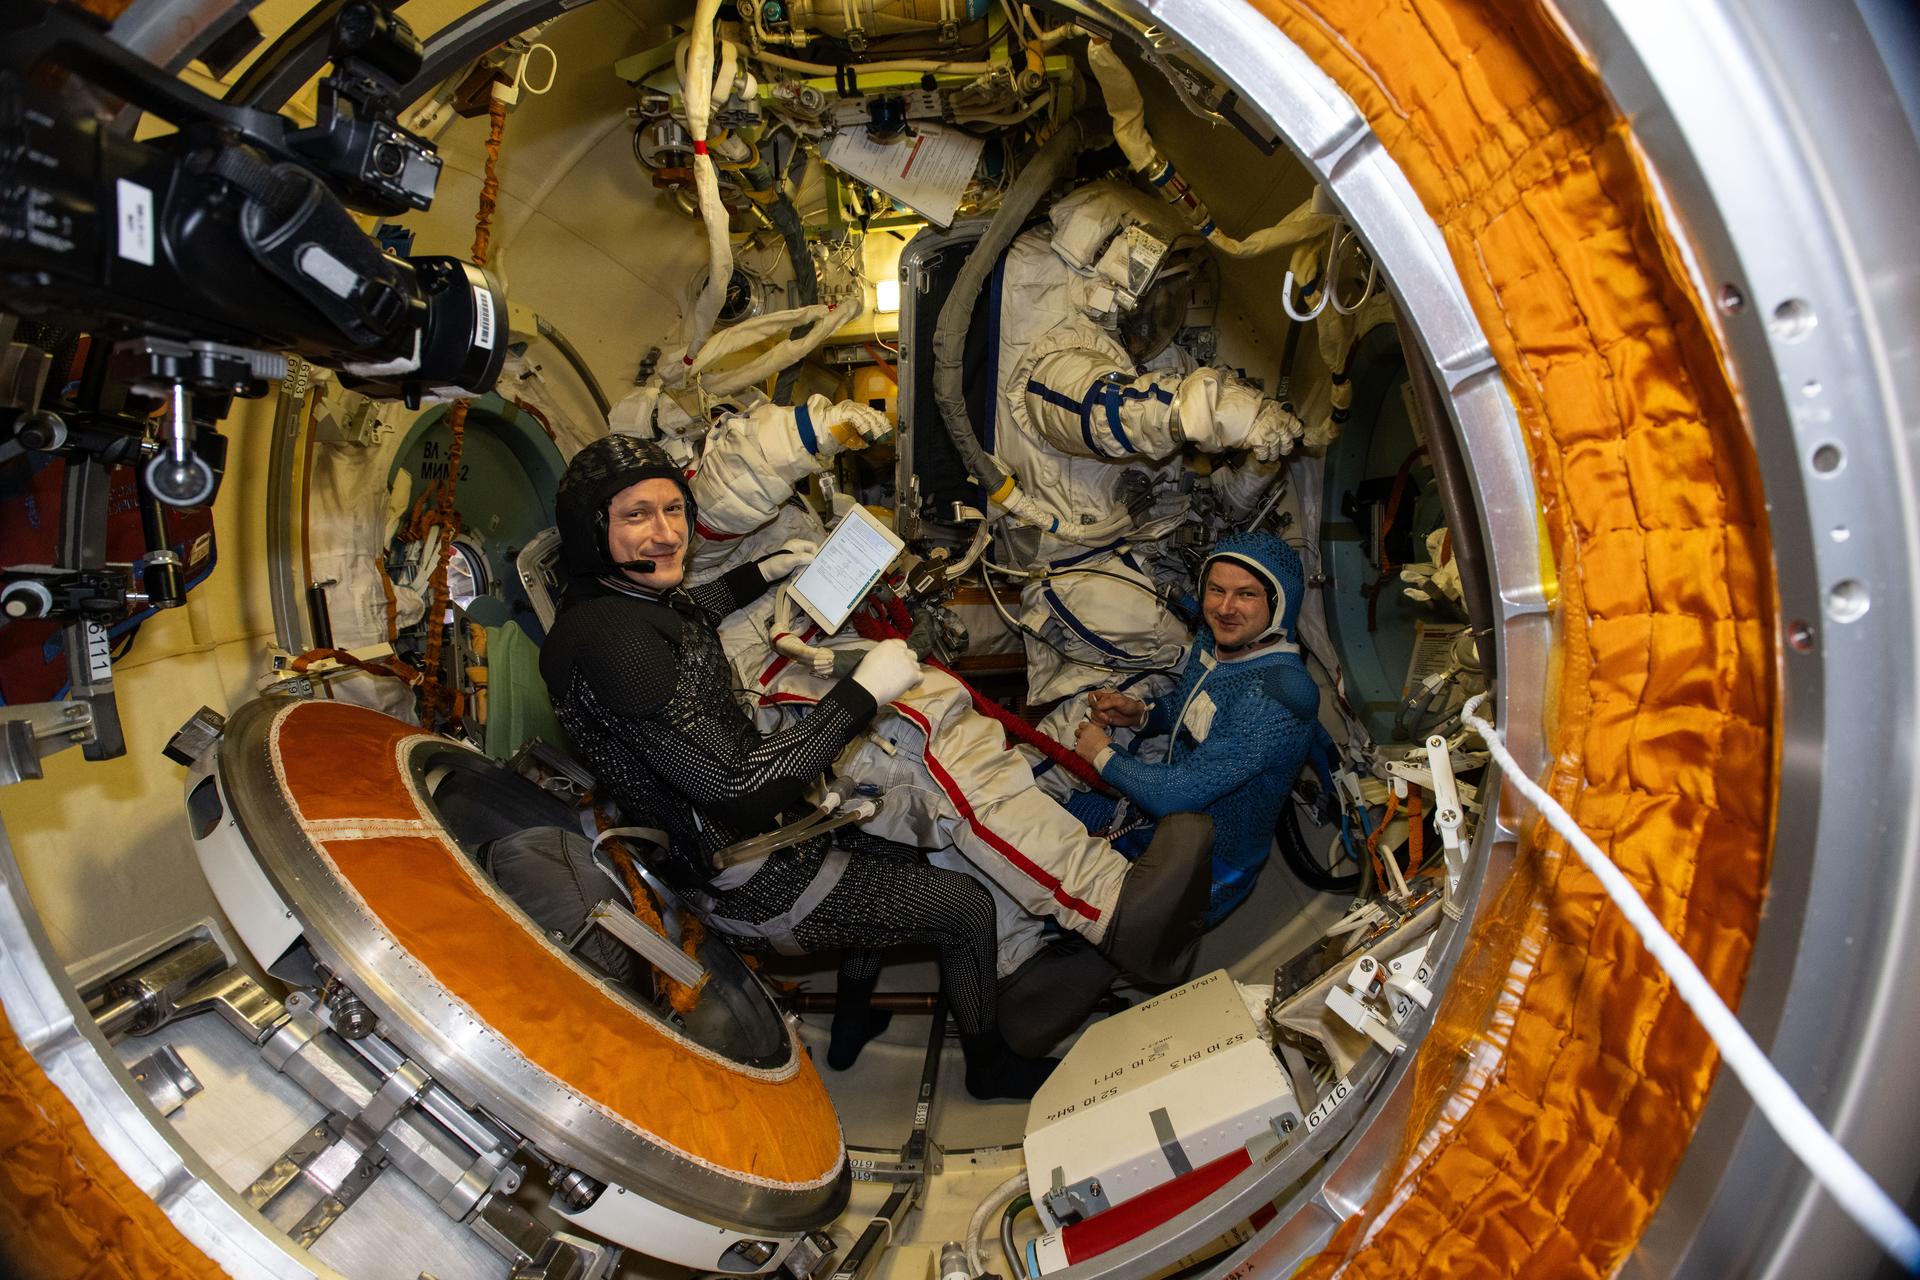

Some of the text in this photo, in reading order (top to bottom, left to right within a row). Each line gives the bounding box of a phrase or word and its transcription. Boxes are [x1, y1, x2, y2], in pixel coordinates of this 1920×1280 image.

[295, 364, 311, 394] 6103
[88, 623, 109, 670] 6111
[1225, 1033, 1244, 1046] 52
[1100, 1086, 1118, 1101] 52
[1308, 1082, 1348, 1128] 6116
